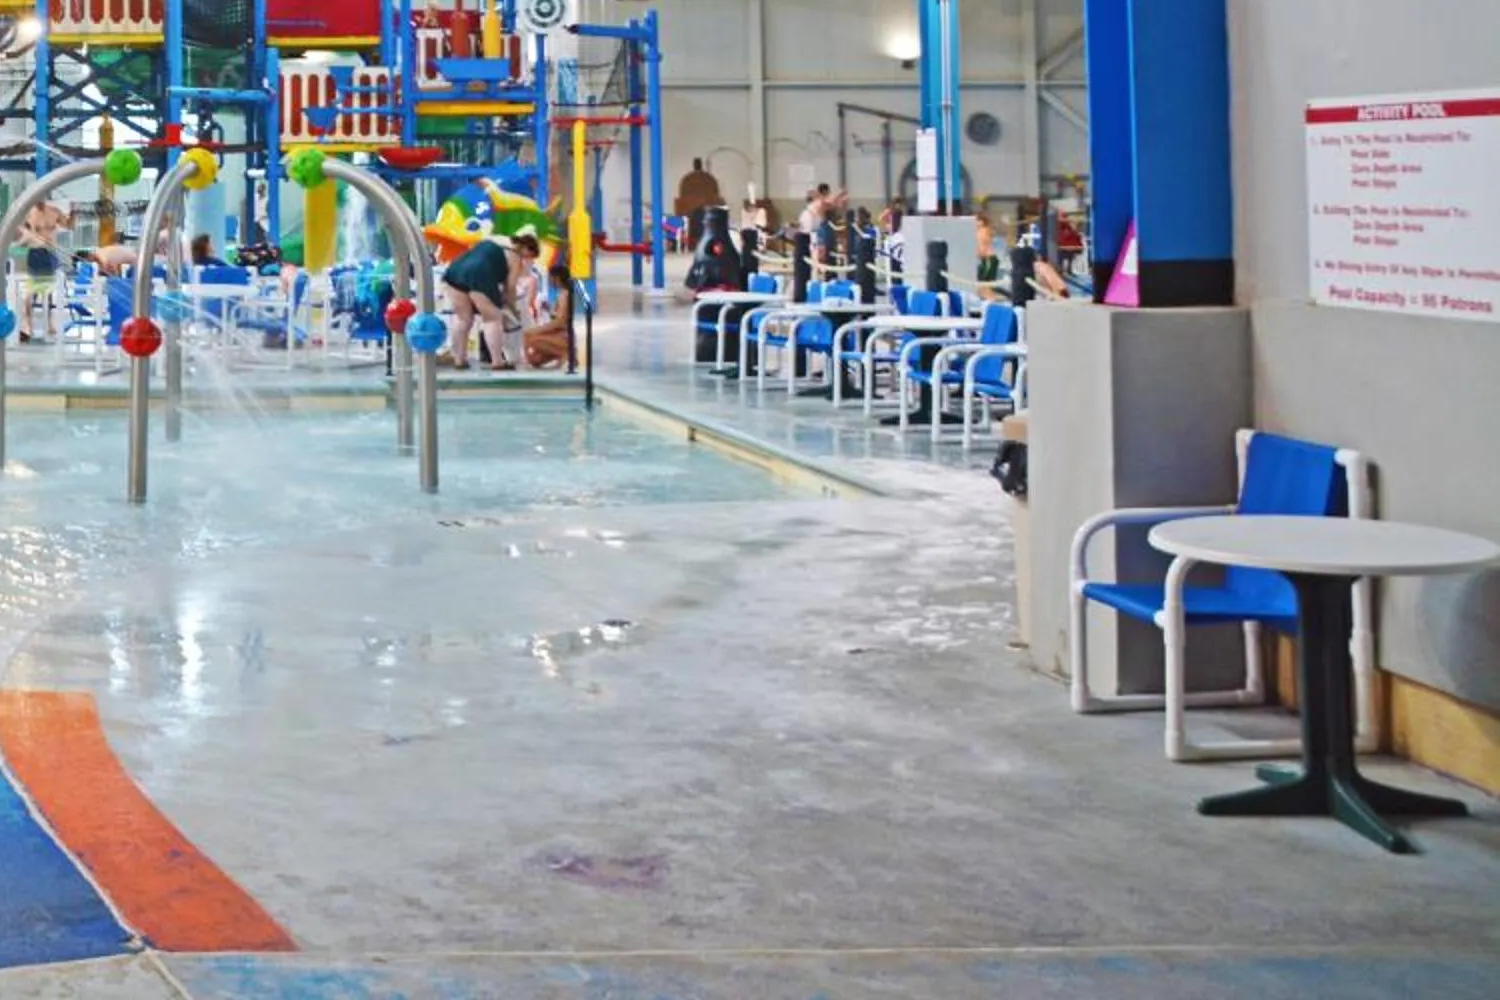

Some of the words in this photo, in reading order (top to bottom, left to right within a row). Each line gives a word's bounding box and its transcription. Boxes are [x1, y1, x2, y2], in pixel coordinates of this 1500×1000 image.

[1358, 104, 1408, 121] ACTIVITY
[1411, 102, 1447, 119] POOL
[1329, 284, 1353, 299] Pool
[1355, 287, 1405, 307] Capacity
